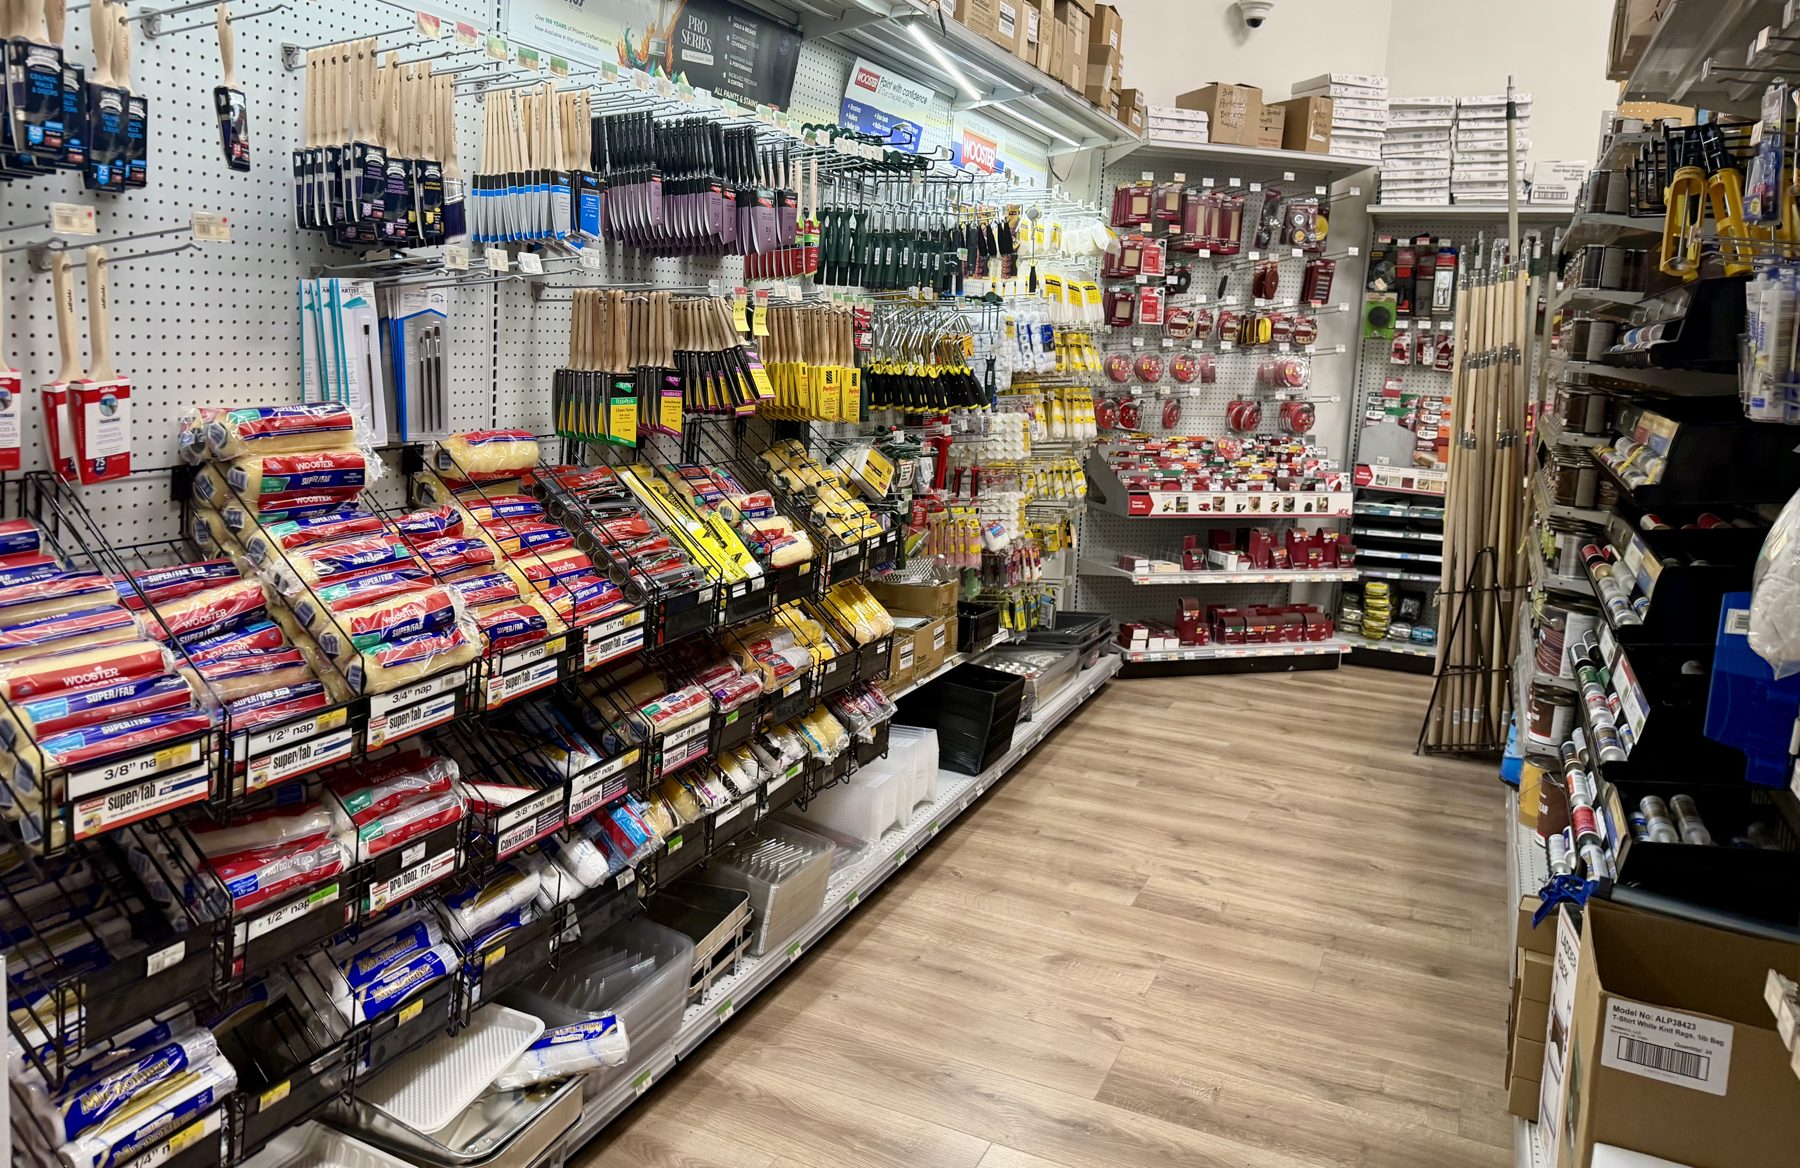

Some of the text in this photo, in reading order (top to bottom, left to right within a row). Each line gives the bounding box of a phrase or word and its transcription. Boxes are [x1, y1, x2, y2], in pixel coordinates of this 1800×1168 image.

[534, 14, 546, 22] Over
[554, 20, 567, 30] YEARS
[572, 26, 586, 36] Proven
[586, 32, 612, 46] Craftsmanship
[688, 14, 708, 35] PRO
[544, 28, 562, 38] Available
[574, 38, 586, 48] United
[587, 42, 599, 52] States
[680, 28, 712, 53] SERIES
[856, 70, 880, 88] WOOSTER
[38, 88, 58, 96] DOORS
[714, 86, 722, 97] ALL
[723, 89, 739, 102] PAINTS
[743, 97, 758, 108] STAINS
[880, 76, 928, 105] Paint with confidence
[30, 127, 40, 135] 50
[962, 138, 996, 169] WOOSTER
[99, 166, 108, 174] 75
[272, 404, 308, 413] SUPER/FAB
[96, 458, 106, 466] 75
[296, 456, 334, 471] WOOSTER
[300, 474, 332, 486] SUPER/FAB
[294, 495, 332, 504] WOOSTER
[491, 496, 520, 504] WOOSTER
[500, 504, 524, 513] SUPER/FAB
[308, 514, 342, 524] SUPER/FAB
[1336, 508, 1350, 516] ACE
[528, 534, 550, 542] SUPER/FAB
[148, 568, 189, 583] SUPER/FAB
[552, 562, 576, 573] WOOSTER
[4, 573, 53, 587] SUPER/FAB
[358, 572, 395, 588] SUPER/FAB
[458, 579, 485, 591] SUPER/FAB
[556, 574, 580, 585] SUPER/FAB
[577, 586, 598, 600] SUPER/FAB
[182, 608, 228, 629] WOOSTER
[382, 608, 418, 624] WOOSTER
[178, 624, 222, 645] SUPER/FAB
[392, 622, 424, 638] SUPER/FAB
[496, 623, 524, 634] SUPER/FAB
[520, 646, 544, 660] 1" nap
[600, 636, 620, 654] super/fab
[62, 666, 119, 686] WOOSTER
[490, 678, 504, 689] WOOSTER
[506, 670, 530, 690] super/fab
[86, 685, 136, 704] SUPER/FAB
[233, 690, 274, 707] SUPER/FAB
[392, 684, 432, 704] 3/4" nap
[101, 716, 152, 734] SUPER/FAB
[370, 718, 388, 729] WOOSTER
[389, 706, 422, 730] super/fab
[266, 722, 314, 744] 1/2" nap
[274, 744, 312, 770] super/fab
[664, 751, 686, 768] CONTRACTOR
[104, 758, 157, 781] 3/8" na
[588, 764, 614, 782] 1/2" nap
[79, 786, 173, 812] WOOSTER KNIT
[108, 782, 156, 812] super/fab
[162, 774, 193, 786] High-capacity
[571, 790, 600, 814] CONTRACTOR
[514, 798, 544, 820] 3/8" nap
[500, 826, 534, 852] CONTRACTOR
[389, 862, 431, 894] pro/dooz FTP
[266, 898, 310, 926] 1/2" nap
[1560, 930, 1576, 972] LADDER
[1558, 952, 1568, 984] RACK
[1612, 1005, 1696, 1030] Model No: ALP38423
[1612, 1014, 1636, 1026] T-Shirt
[1637, 1020, 1657, 1031] White
[1658, 1024, 1674, 1034] Knit
[1675, 1027, 1695, 1040] Rags,
[1698, 1034, 1709, 1043] 1lb
[1710, 1036, 1724, 1047] Bag
[1674, 1042, 1703, 1054] Quantity:
